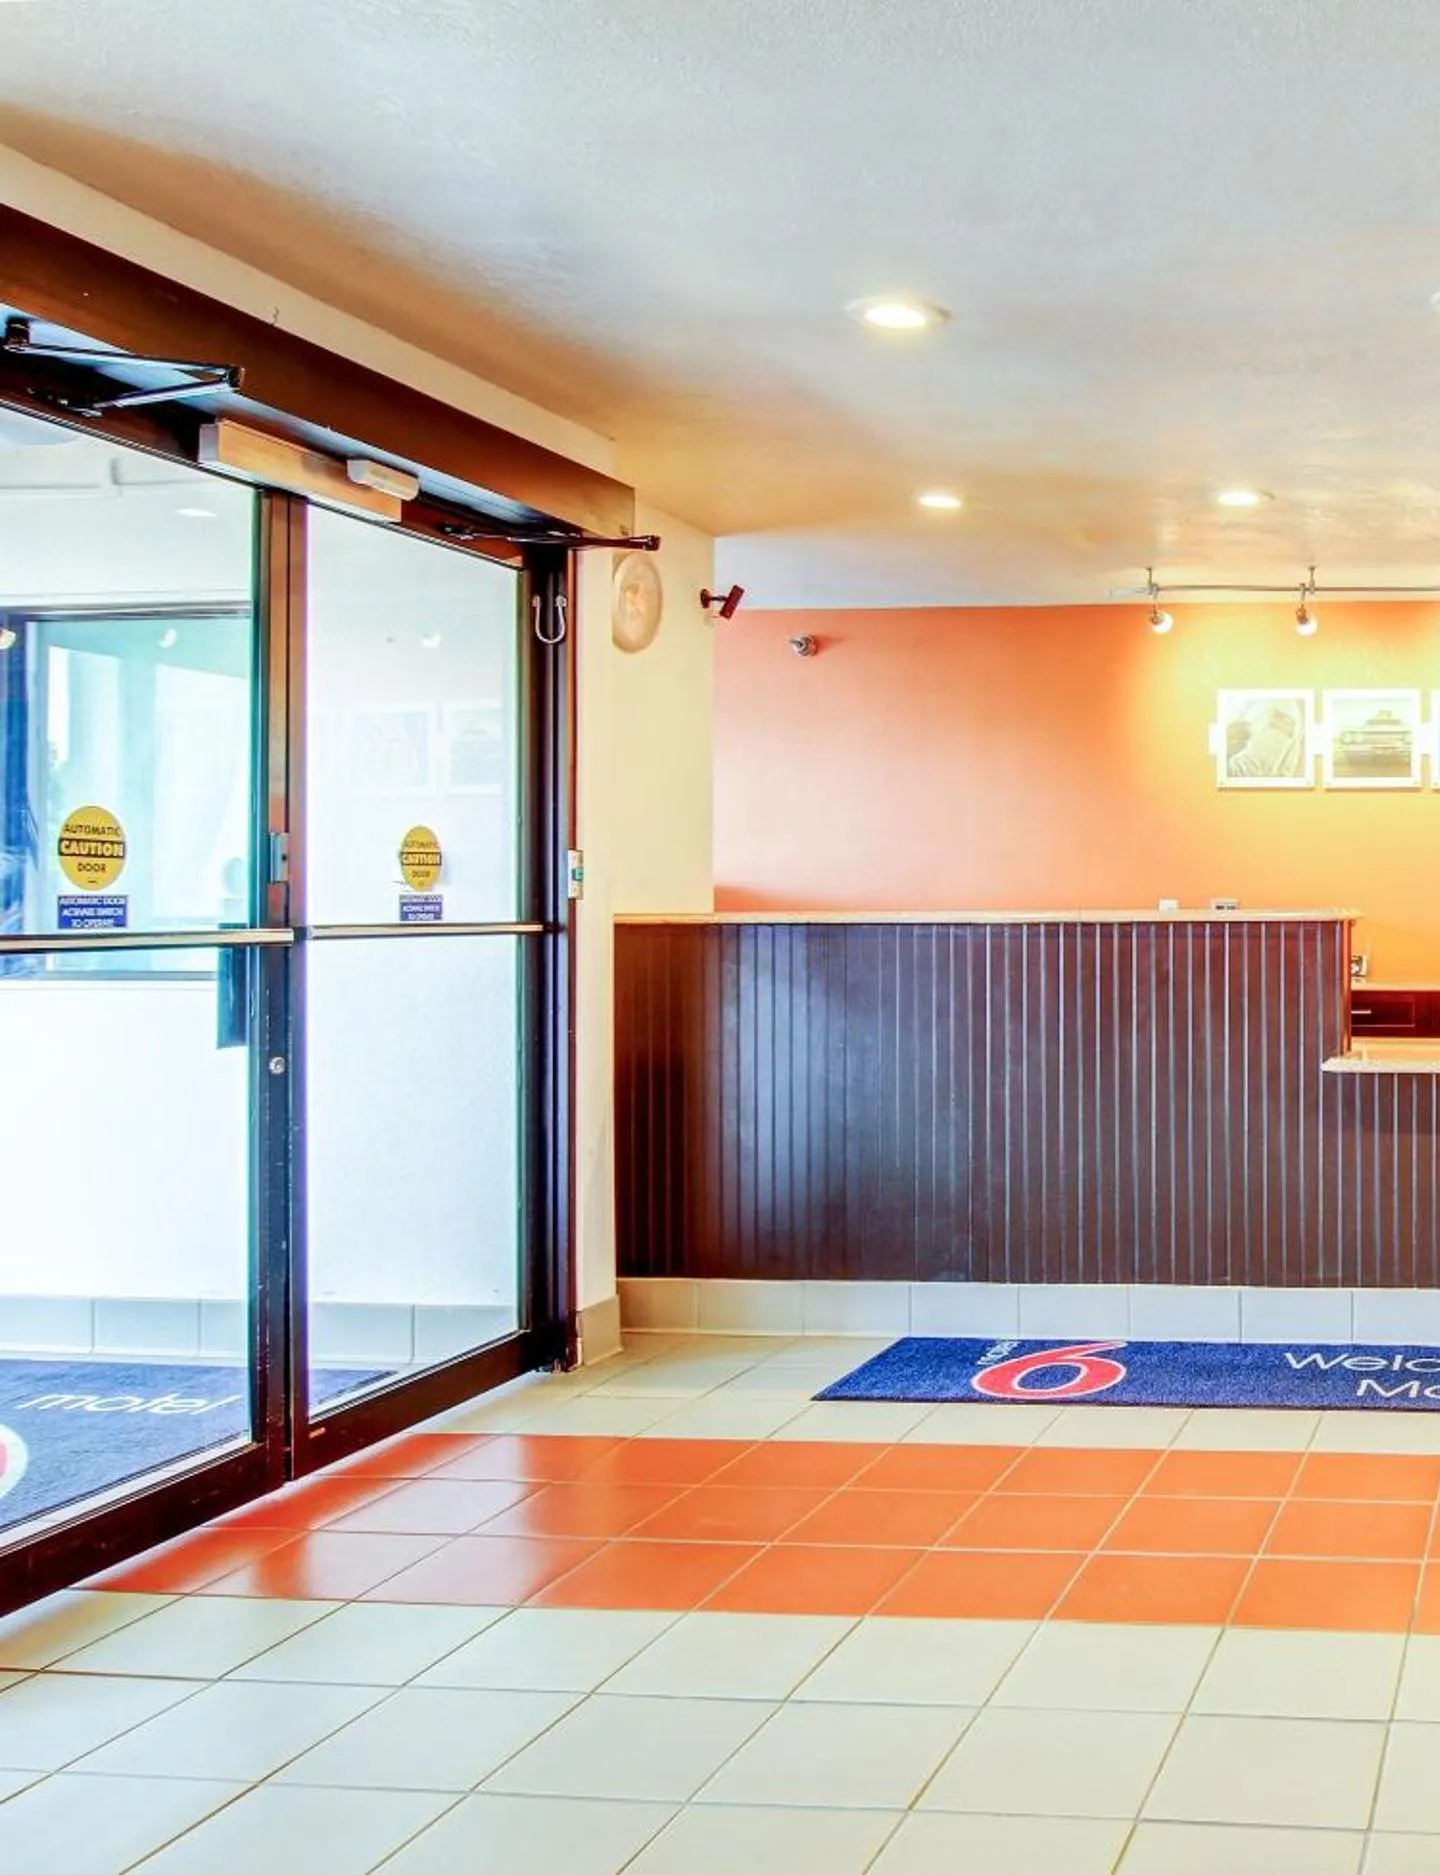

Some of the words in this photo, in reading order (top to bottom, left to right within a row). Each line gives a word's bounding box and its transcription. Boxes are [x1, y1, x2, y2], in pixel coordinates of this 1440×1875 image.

[63, 823, 121, 837] AUTOMATIC
[60, 840, 125, 858] CAUTION
[77, 862, 107, 874] DOOR
[970, 1339, 1128, 1399] 6
